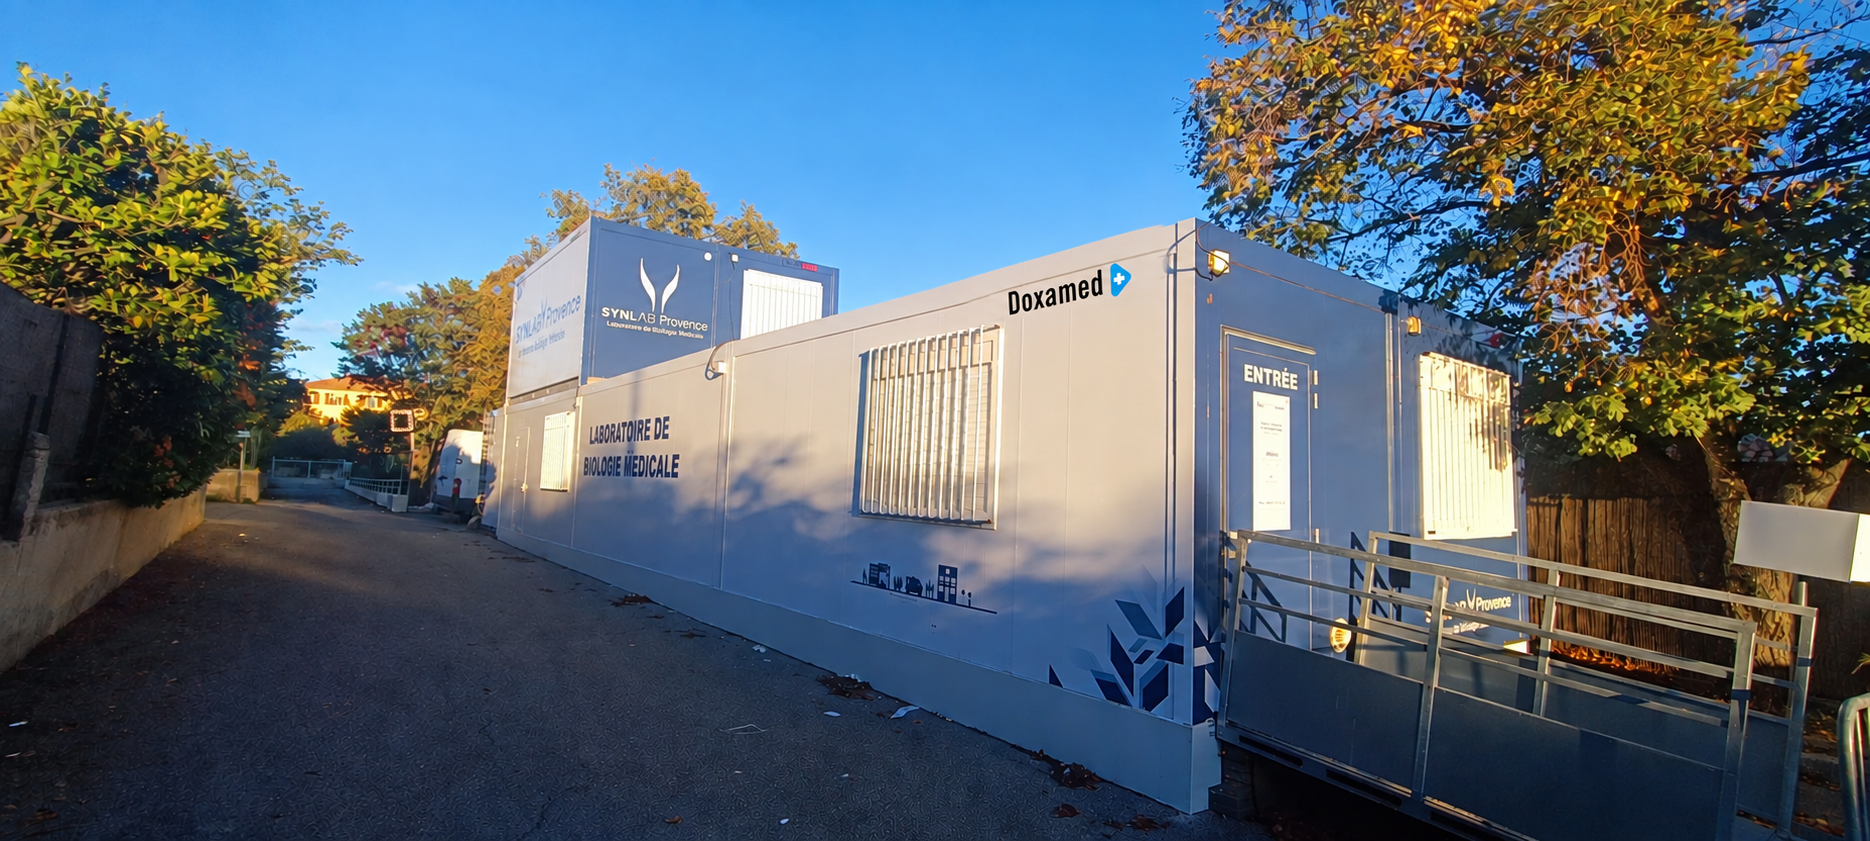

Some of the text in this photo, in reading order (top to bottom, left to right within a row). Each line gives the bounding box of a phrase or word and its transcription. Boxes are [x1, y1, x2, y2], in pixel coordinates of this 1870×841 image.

[1008, 269, 1103, 315] Doxamed
[601, 307, 708, 332] SYNLAB Provence
[1244, 363, 1298, 390] ENTRÉE
[589, 416, 670, 445] LABORATOIRE DE
[583, 456, 622, 476] BIOLOGIE
[1476, 596, 1512, 611] Provence
